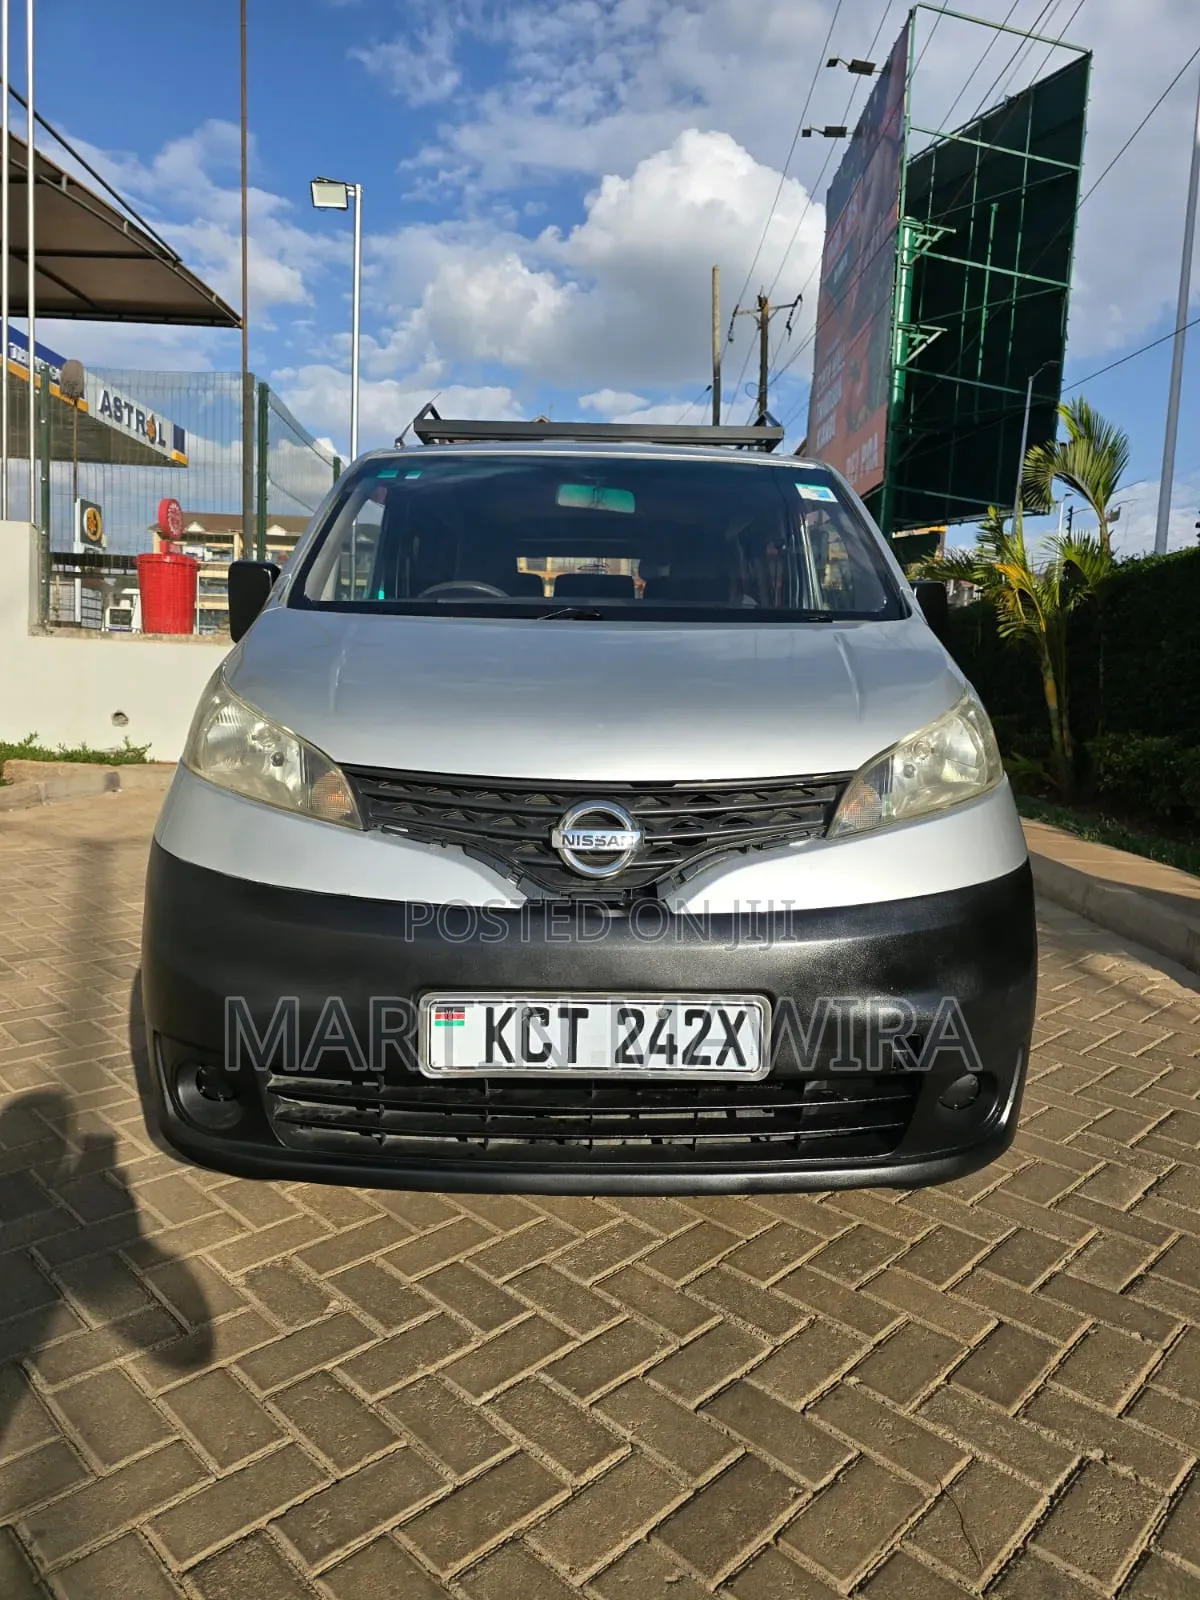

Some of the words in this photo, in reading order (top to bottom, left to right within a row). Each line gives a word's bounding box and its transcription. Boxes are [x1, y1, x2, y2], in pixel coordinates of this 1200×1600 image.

[561, 833, 635, 847] NISSAN
[485, 1006, 589, 1065] KCT
[615, 1007, 748, 1067] 242X
